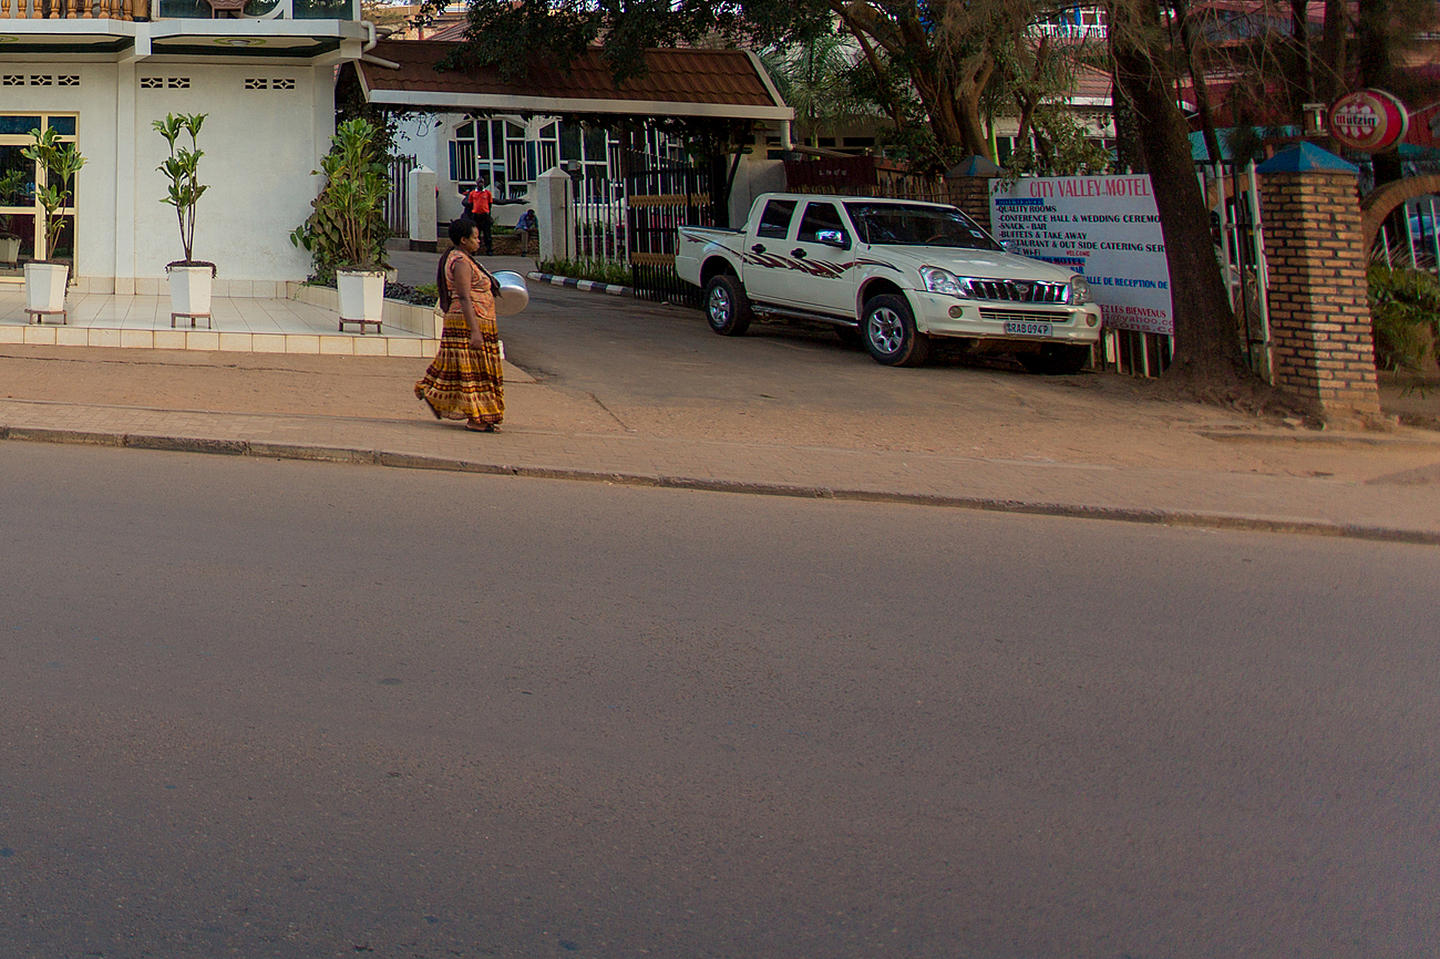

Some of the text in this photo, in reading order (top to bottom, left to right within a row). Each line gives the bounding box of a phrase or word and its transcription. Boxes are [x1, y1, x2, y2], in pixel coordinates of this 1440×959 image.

[1029, 178, 1150, 198] CITY VALLEY MOTEL
[1029, 205, 1057, 213] ROOMS
[1050, 214, 1070, 223] HALL
[1071, 214, 1079, 223] &
[1080, 214, 1121, 223] WEDDING
[1035, 231, 1041, 239] &
[1043, 231, 1063, 239] TAKE
[1064, 232, 1087, 240] AWAY
[1059, 241, 1077, 249] OUT
[1078, 241, 1098, 250] SIDE
[1100, 242, 1144, 252] CATERING
[1084, 276, 1168, 290] ALLE DE RECEPTION DE
[1111, 305, 1124, 314] LES
[1125, 306, 1167, 319] BIENVENUS
